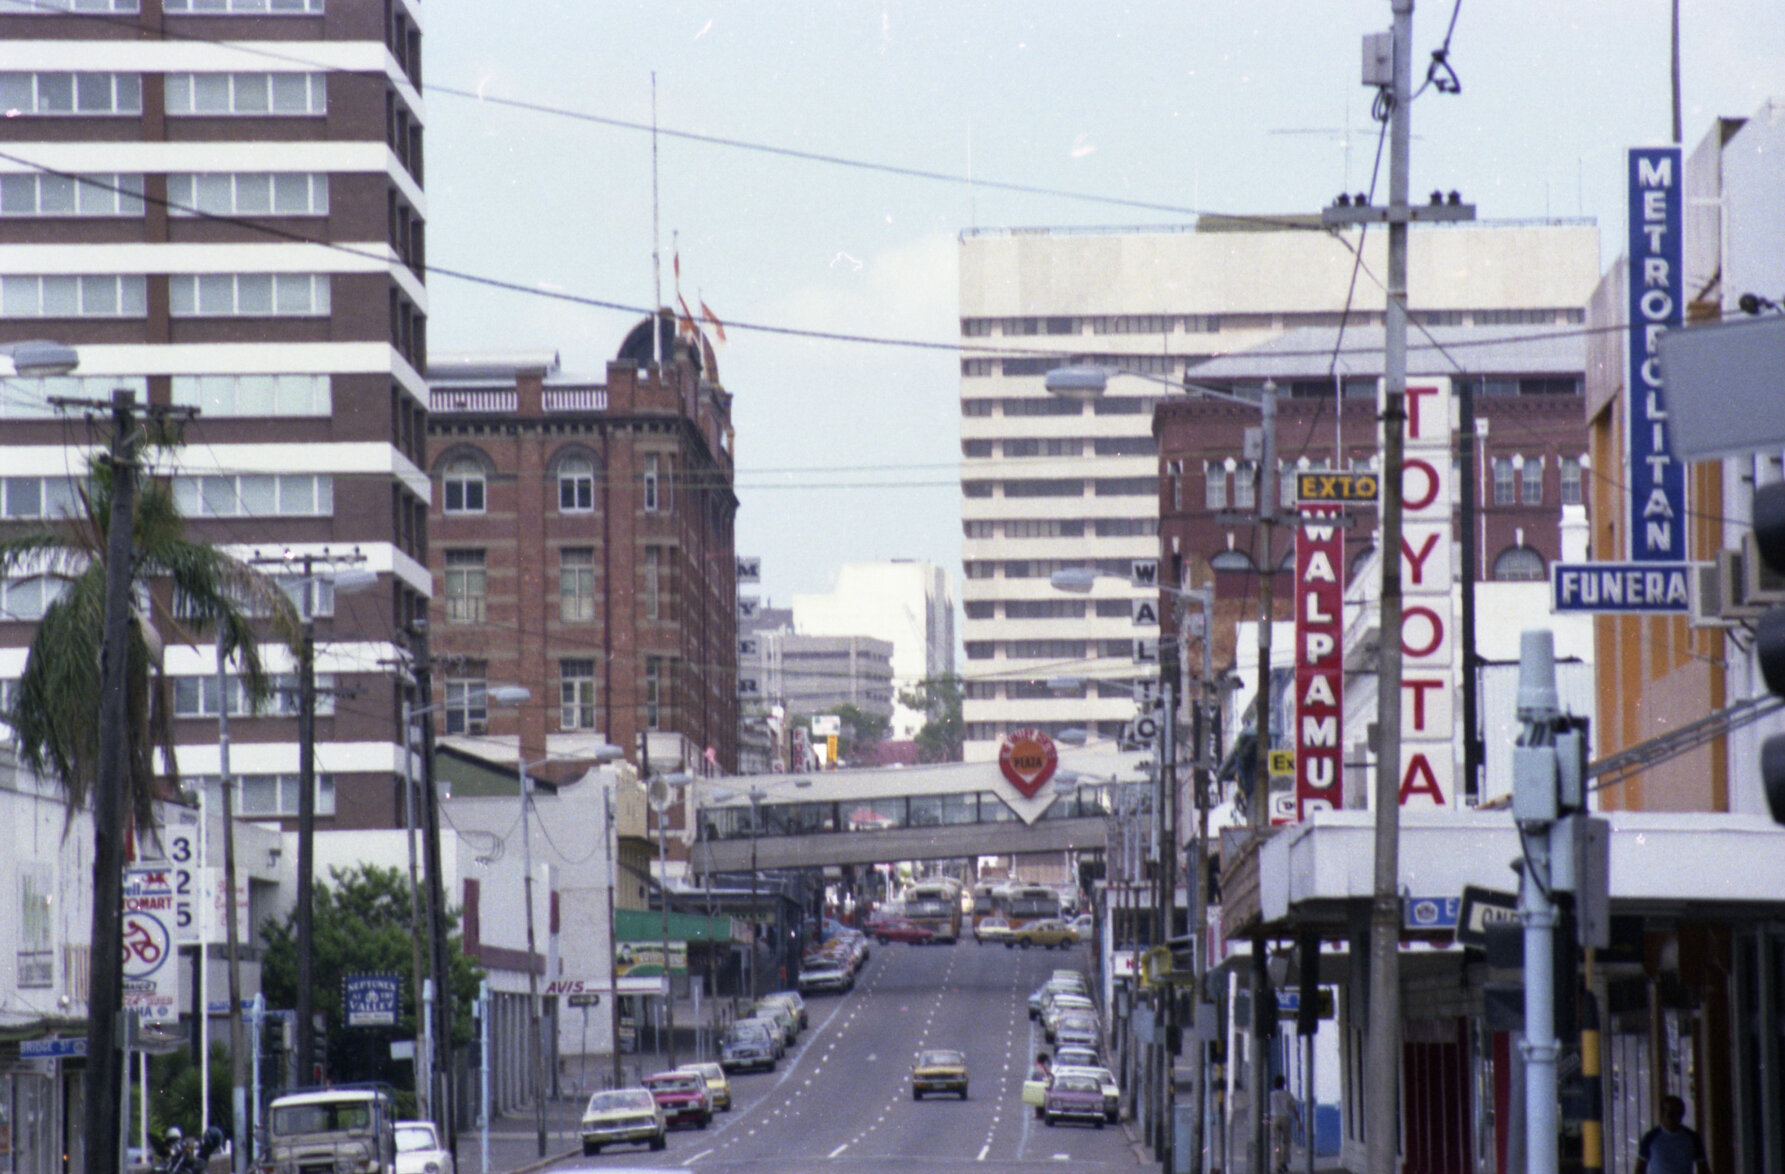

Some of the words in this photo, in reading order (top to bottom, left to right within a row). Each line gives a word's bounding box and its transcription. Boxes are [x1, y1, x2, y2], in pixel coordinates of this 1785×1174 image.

[1301, 477, 1377, 499] EXTO
[1400, 387, 1446, 806] TOYOTA
[738, 562, 759, 693] MYER
[546, 981, 585, 994] AVIS
[349, 1000, 394, 1012] VALLEY
